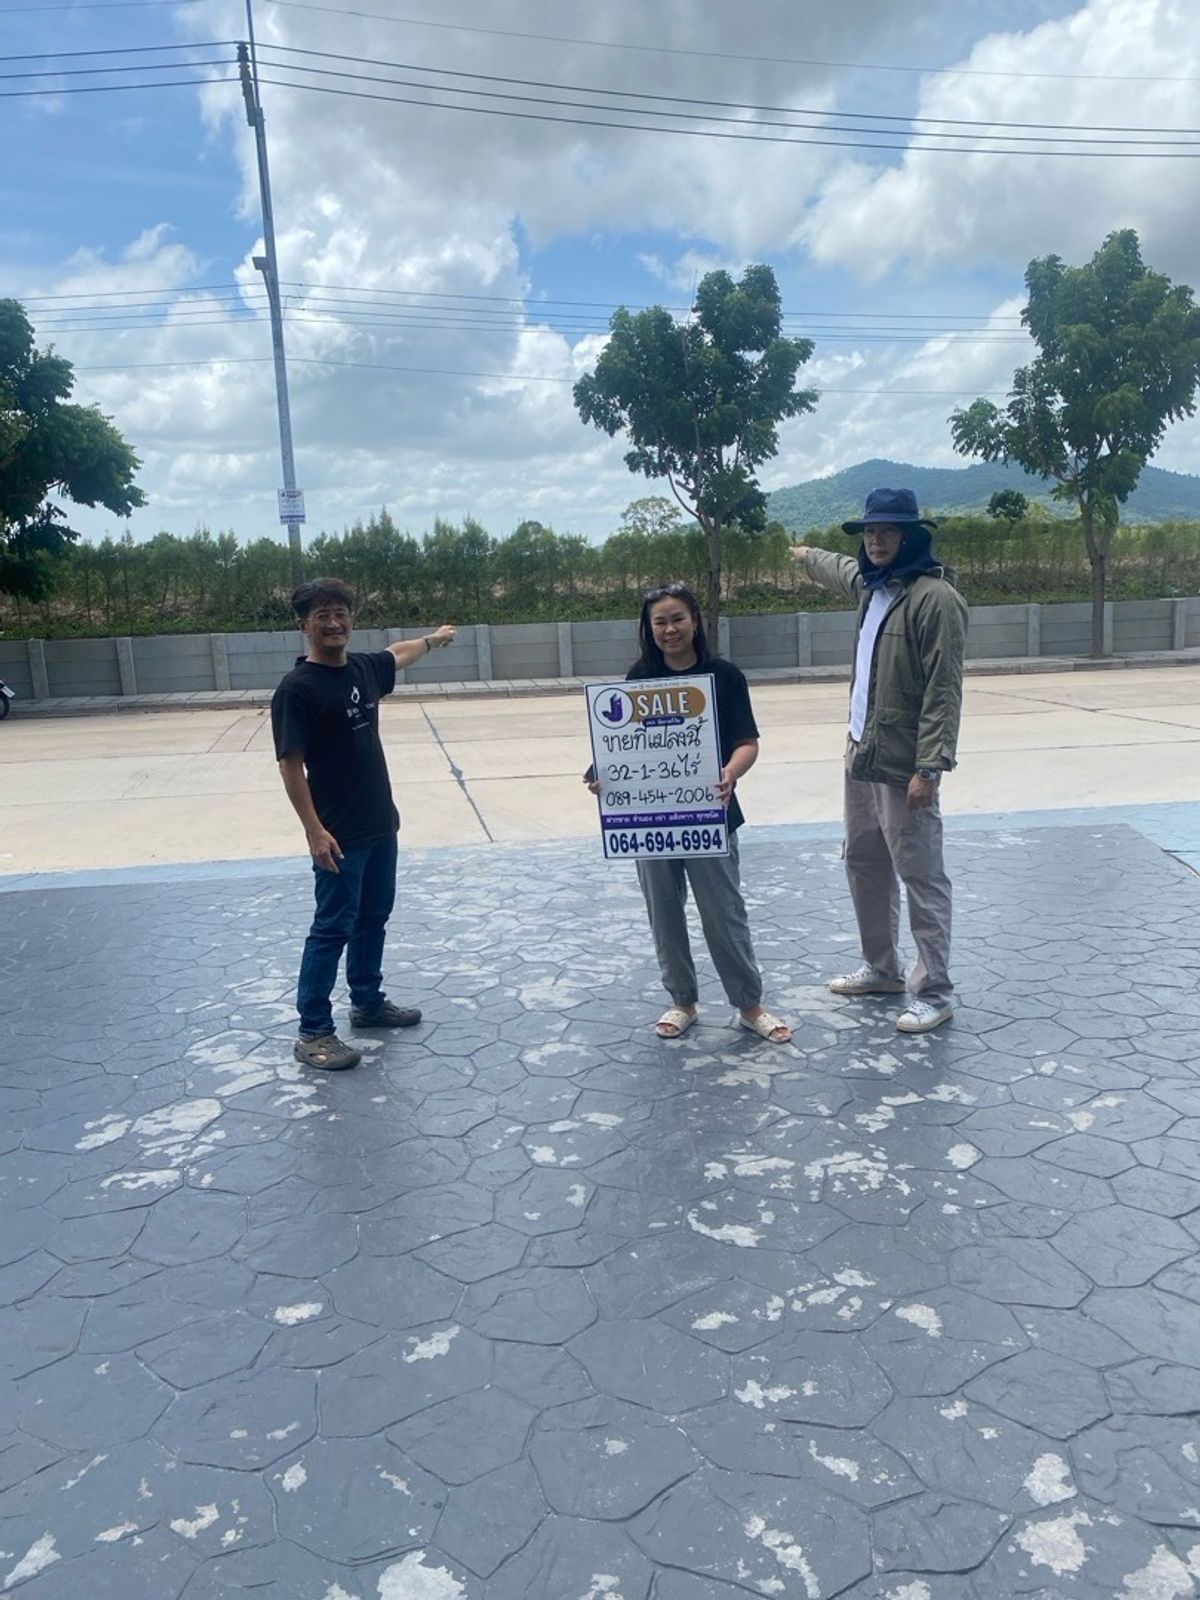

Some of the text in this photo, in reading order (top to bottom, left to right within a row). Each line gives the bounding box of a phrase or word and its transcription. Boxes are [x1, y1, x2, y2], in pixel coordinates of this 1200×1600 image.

[637, 692, 690, 716] SALE
[605, 788, 714, 807] 089-454-2006
[610, 829, 722, 854] 064-694-6994
